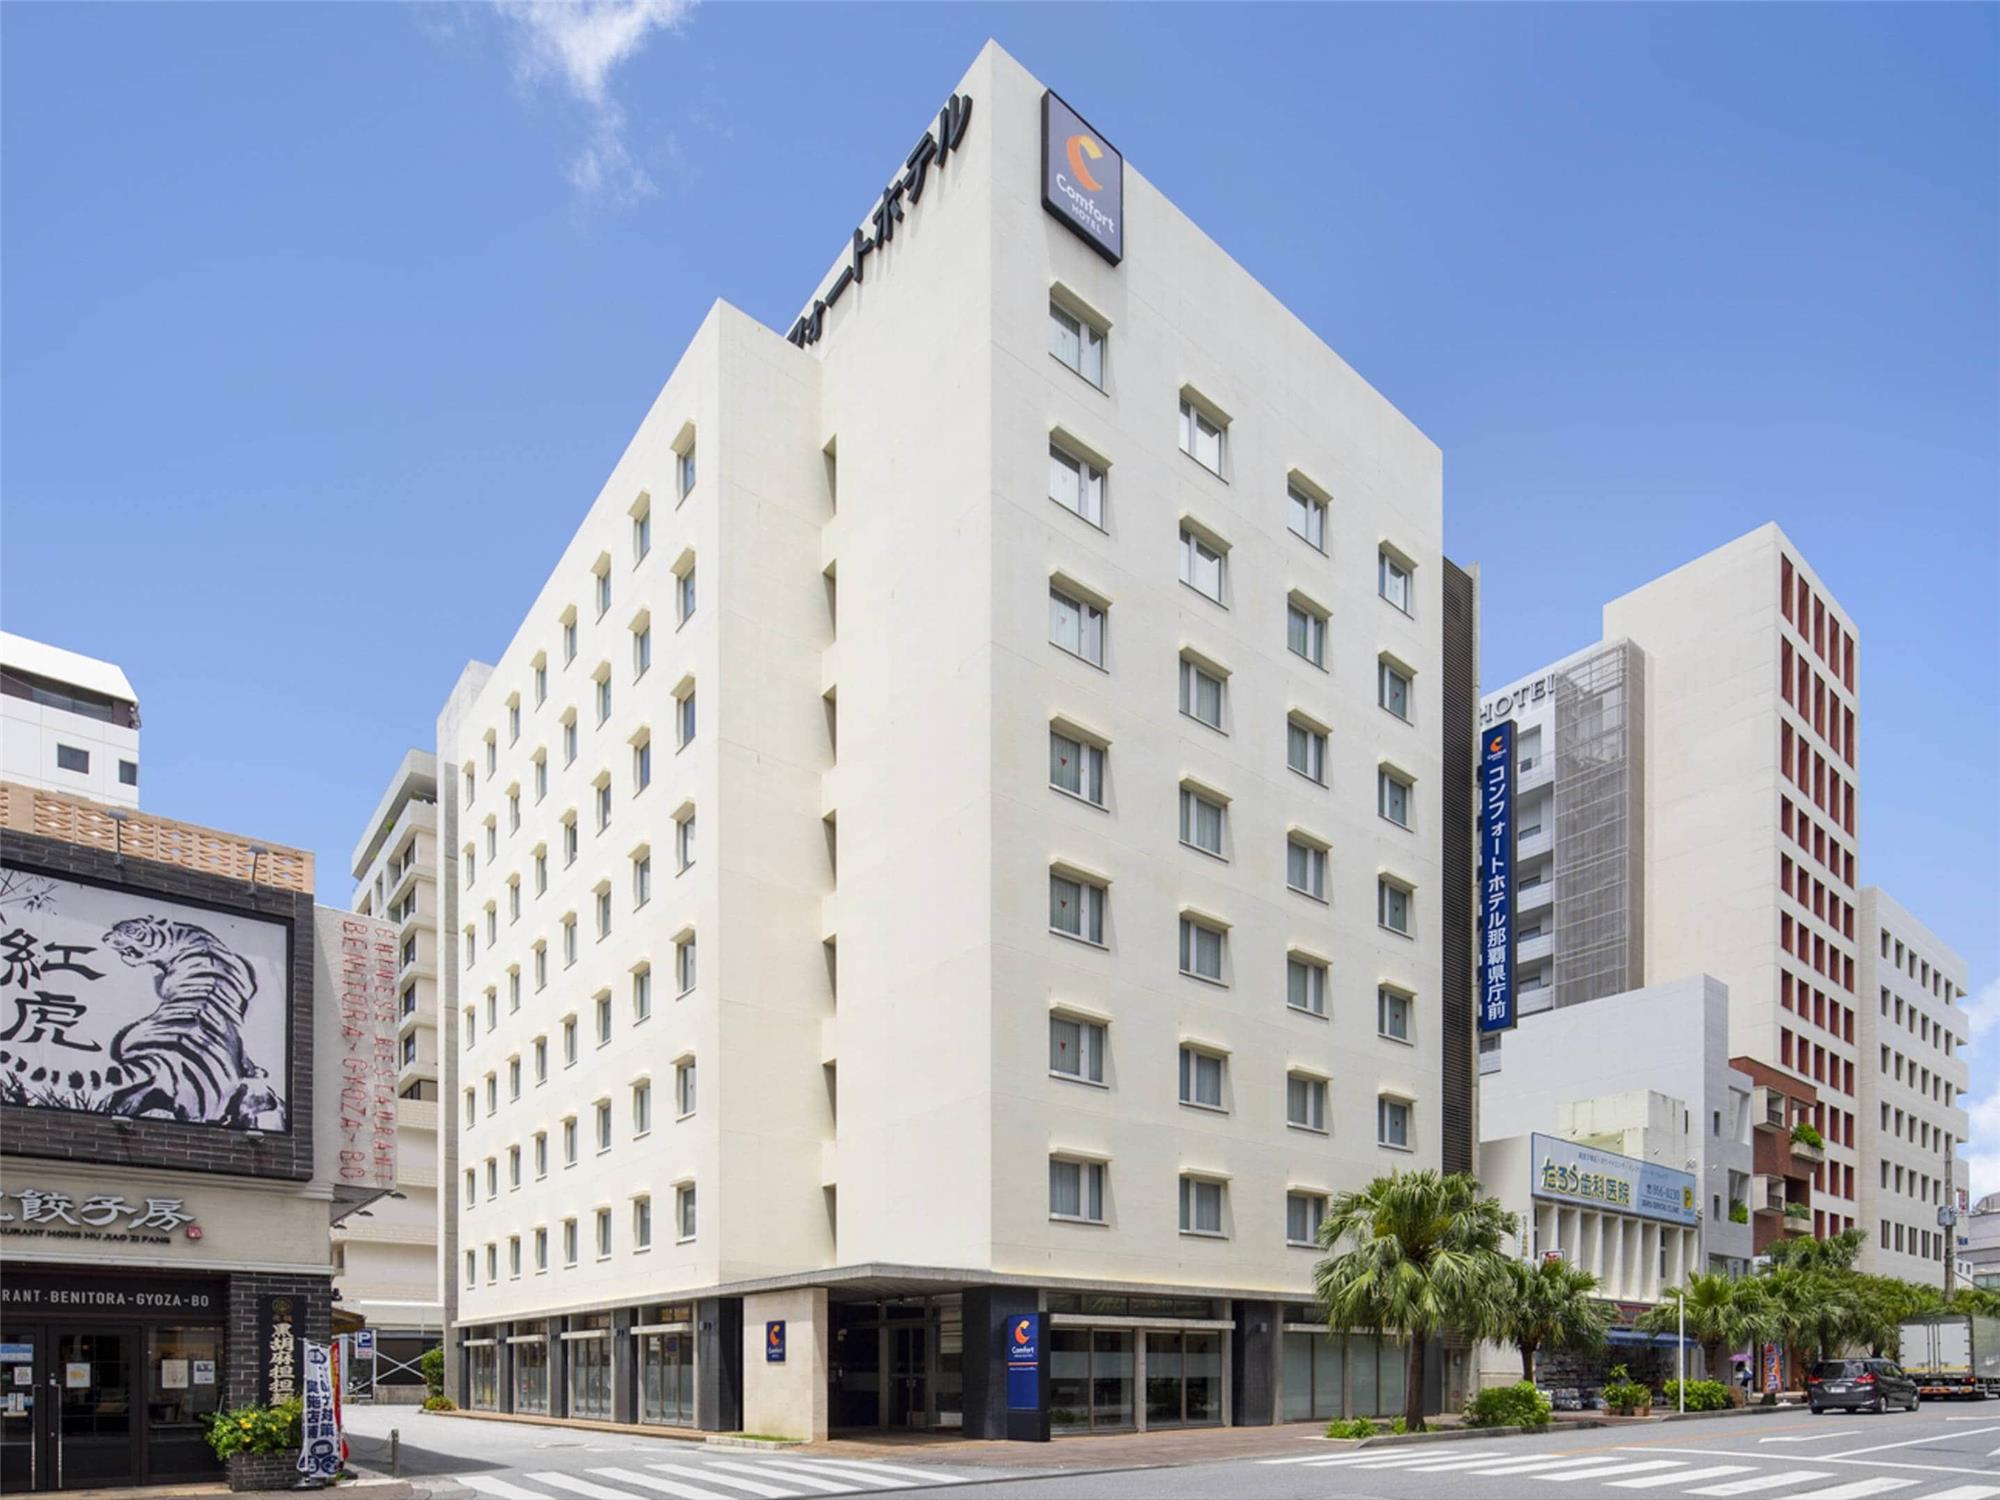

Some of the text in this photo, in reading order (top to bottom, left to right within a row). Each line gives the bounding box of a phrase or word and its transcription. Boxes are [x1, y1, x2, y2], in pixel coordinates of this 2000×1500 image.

[1056, 173, 1115, 234] Comfort
[1071, 203, 1102, 234] HOTEL
[1487, 765, 1506, 1021] コンフォートホテル那覇県庁前
[0, 928, 107, 1052] 紅虎
[374, 927, 398, 1024] CHINESE
[0, 1188, 196, 1232] 餃子房
[47, 1229, 82, 1240] HONG
[84, 1231, 101, 1241] HU
[130, 1235, 140, 1243] ZI
[142, 1236, 171, 1244] FANG
[358, 1331, 371, 1344] P
